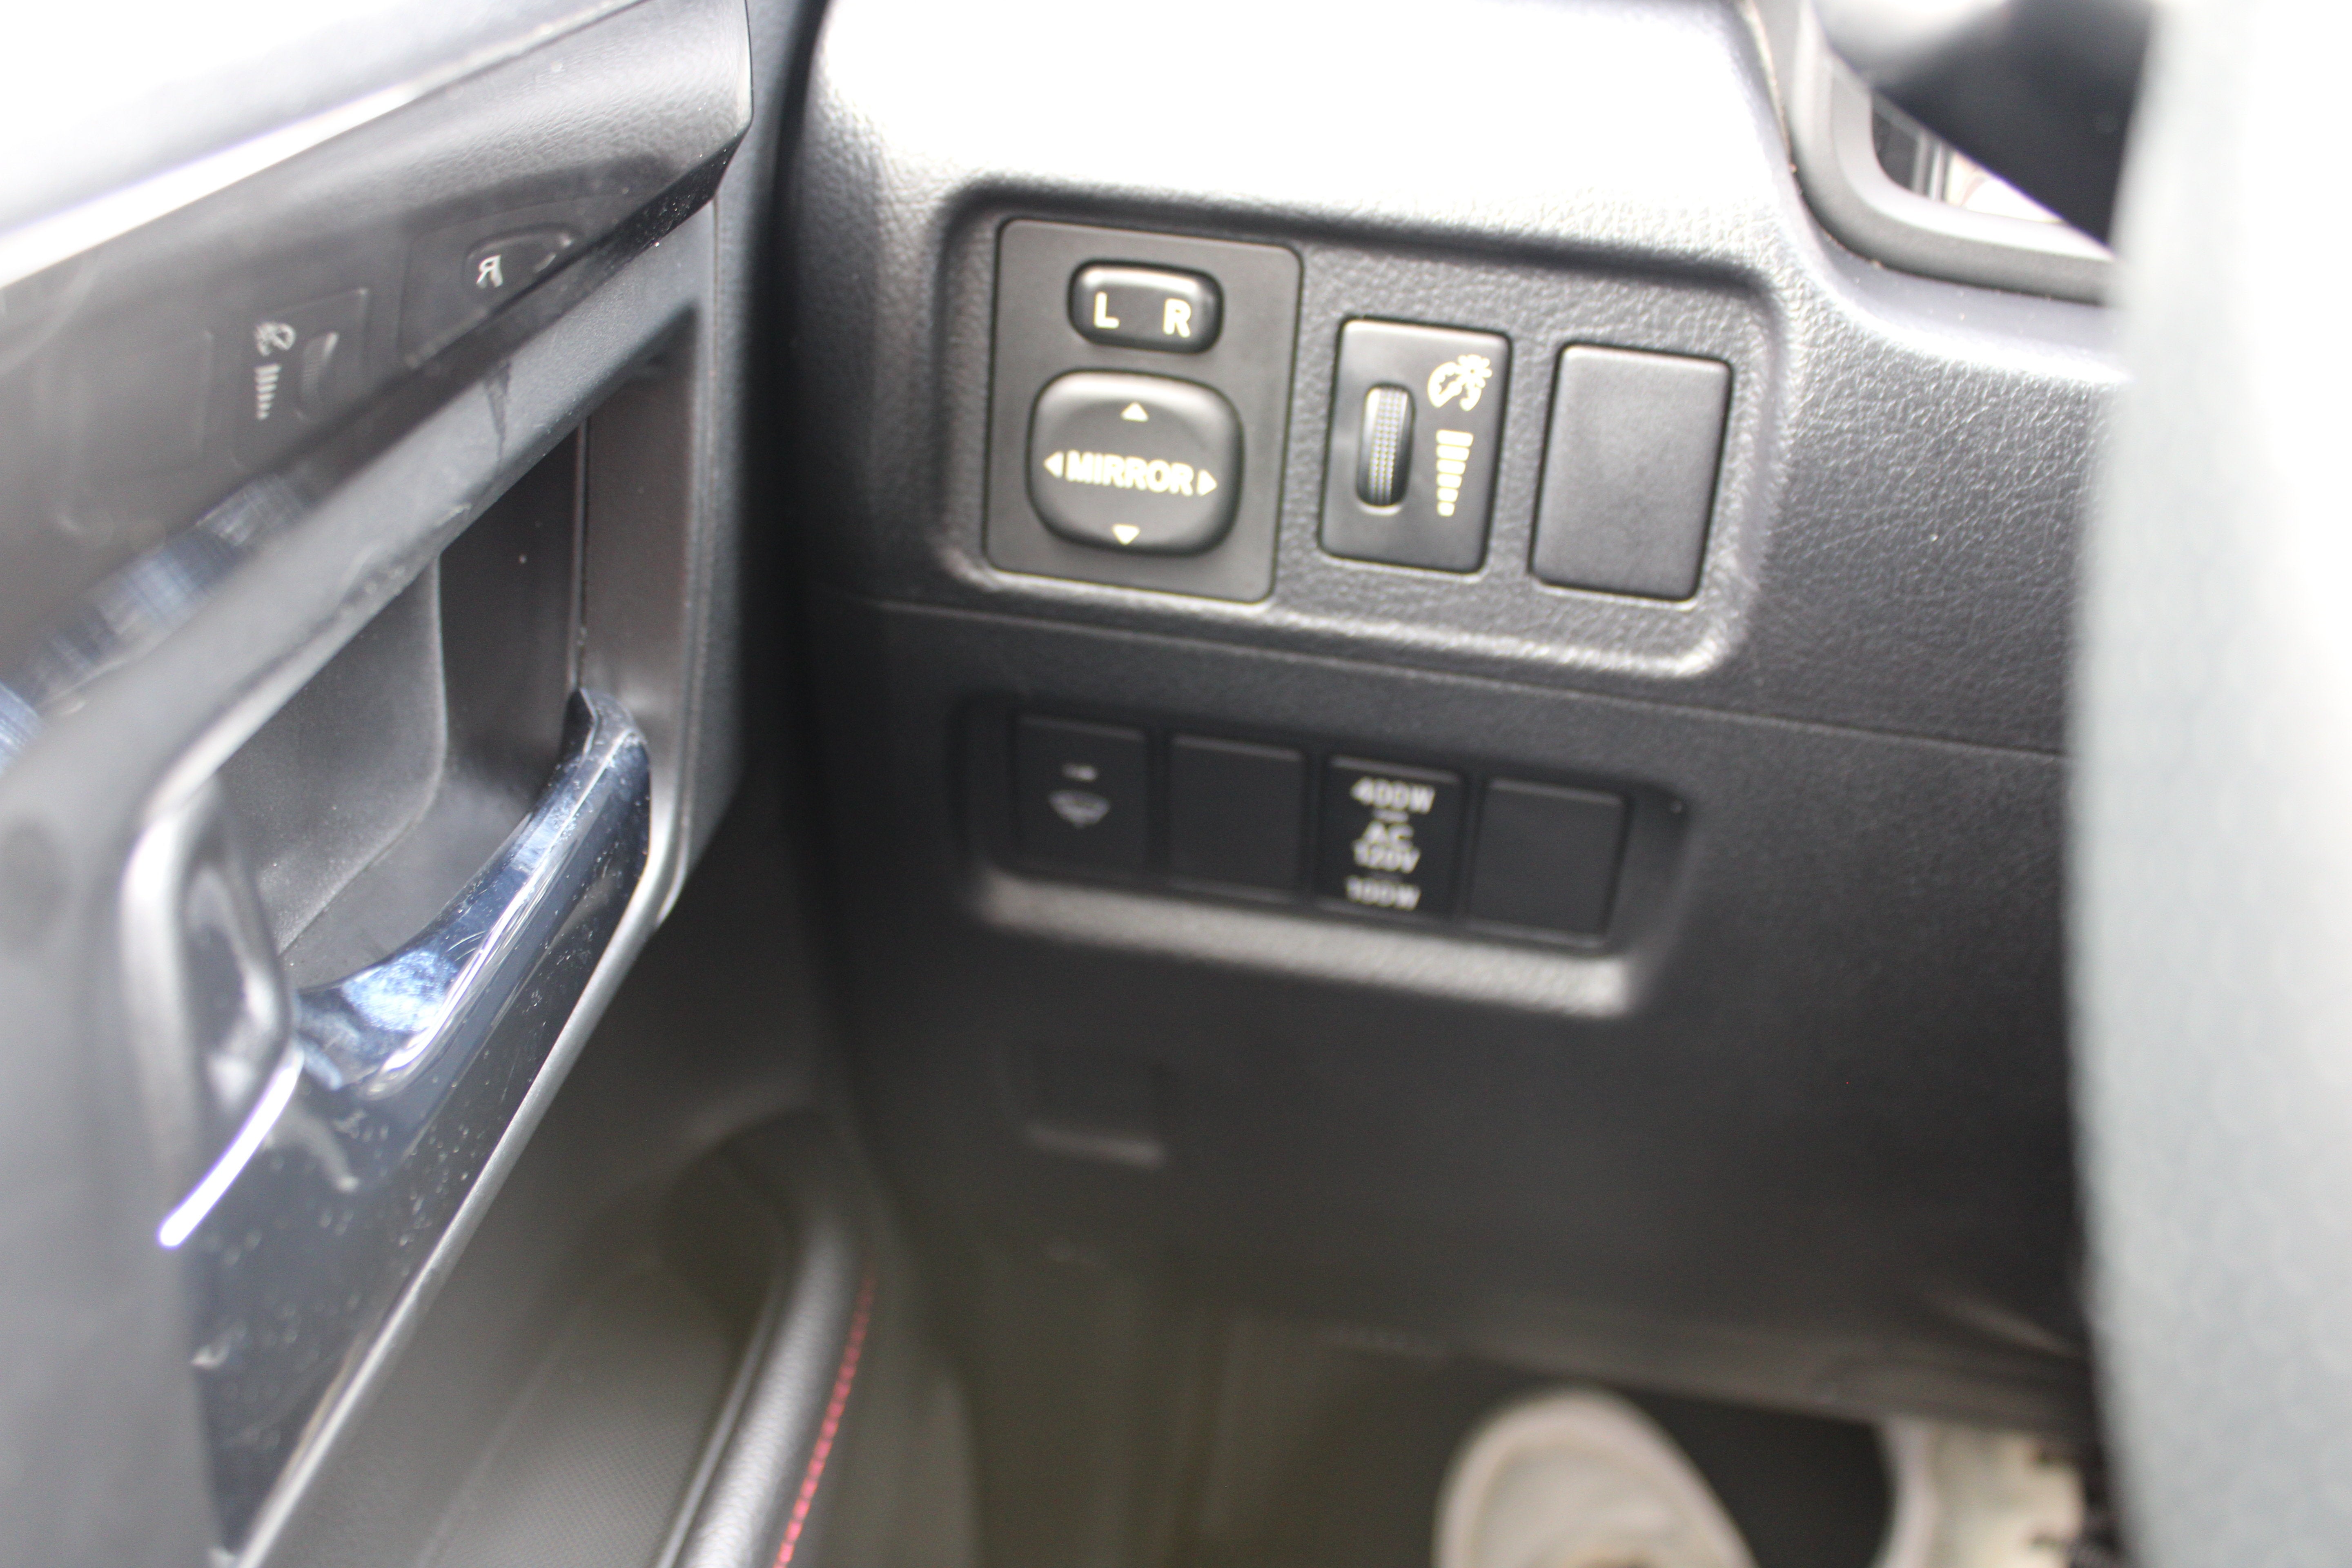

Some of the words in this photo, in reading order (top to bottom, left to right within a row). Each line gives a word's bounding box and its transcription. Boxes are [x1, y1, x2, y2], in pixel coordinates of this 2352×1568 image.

[1094, 292, 1120, 329] L
[1164, 298, 1191, 338] R
[1066, 450, 1194, 497] MIRROR
[1350, 777, 1436, 813] 400W
[1362, 819, 1414, 849] AC
[1352, 840, 1421, 874] 120V
[1346, 875, 1421, 911] 100W
